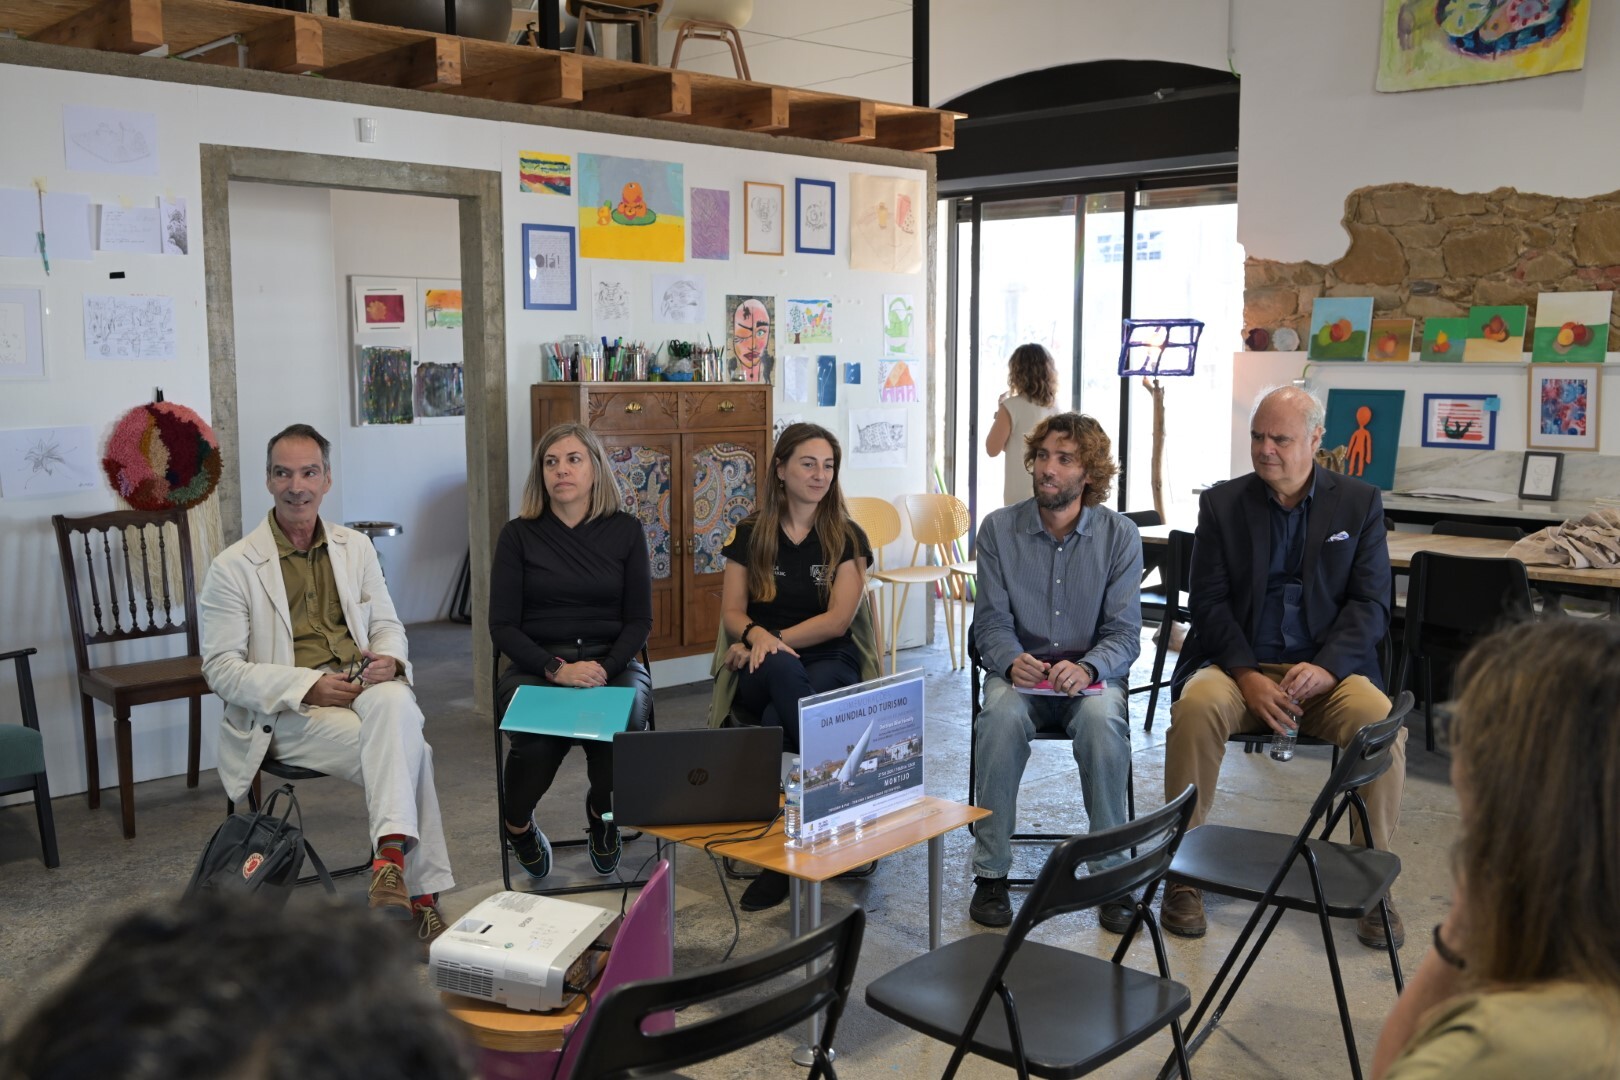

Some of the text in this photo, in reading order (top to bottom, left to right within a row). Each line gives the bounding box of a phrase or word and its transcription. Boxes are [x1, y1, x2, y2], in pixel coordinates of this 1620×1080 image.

[535, 253, 560, 269] Olá!
[821, 716, 833, 728] DIA
[835, 708, 866, 724] MUNDIAL
[868, 704, 878, 716] DO
[879, 696, 908, 713] TURISMO
[688, 768, 709, 786] hp
[884, 772, 910, 786] MONTIJO
